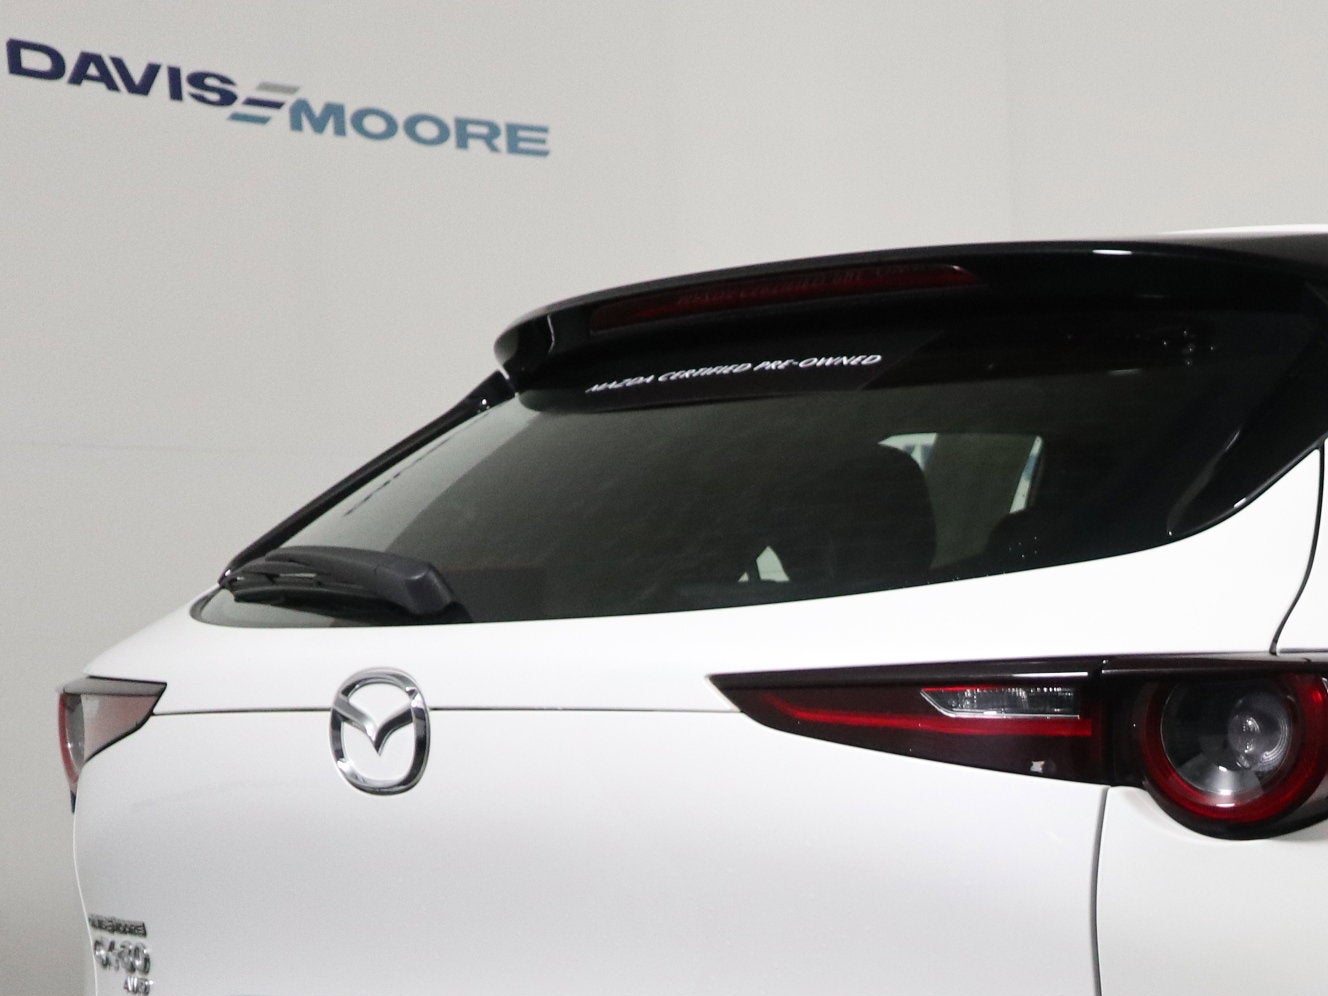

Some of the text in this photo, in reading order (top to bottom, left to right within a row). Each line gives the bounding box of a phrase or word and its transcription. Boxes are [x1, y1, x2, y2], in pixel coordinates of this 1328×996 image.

[6, 38, 550, 158] DAVIS MOORE
[584, 354, 882, 394] MAZDA CERTIFIED PRE-OWNED
